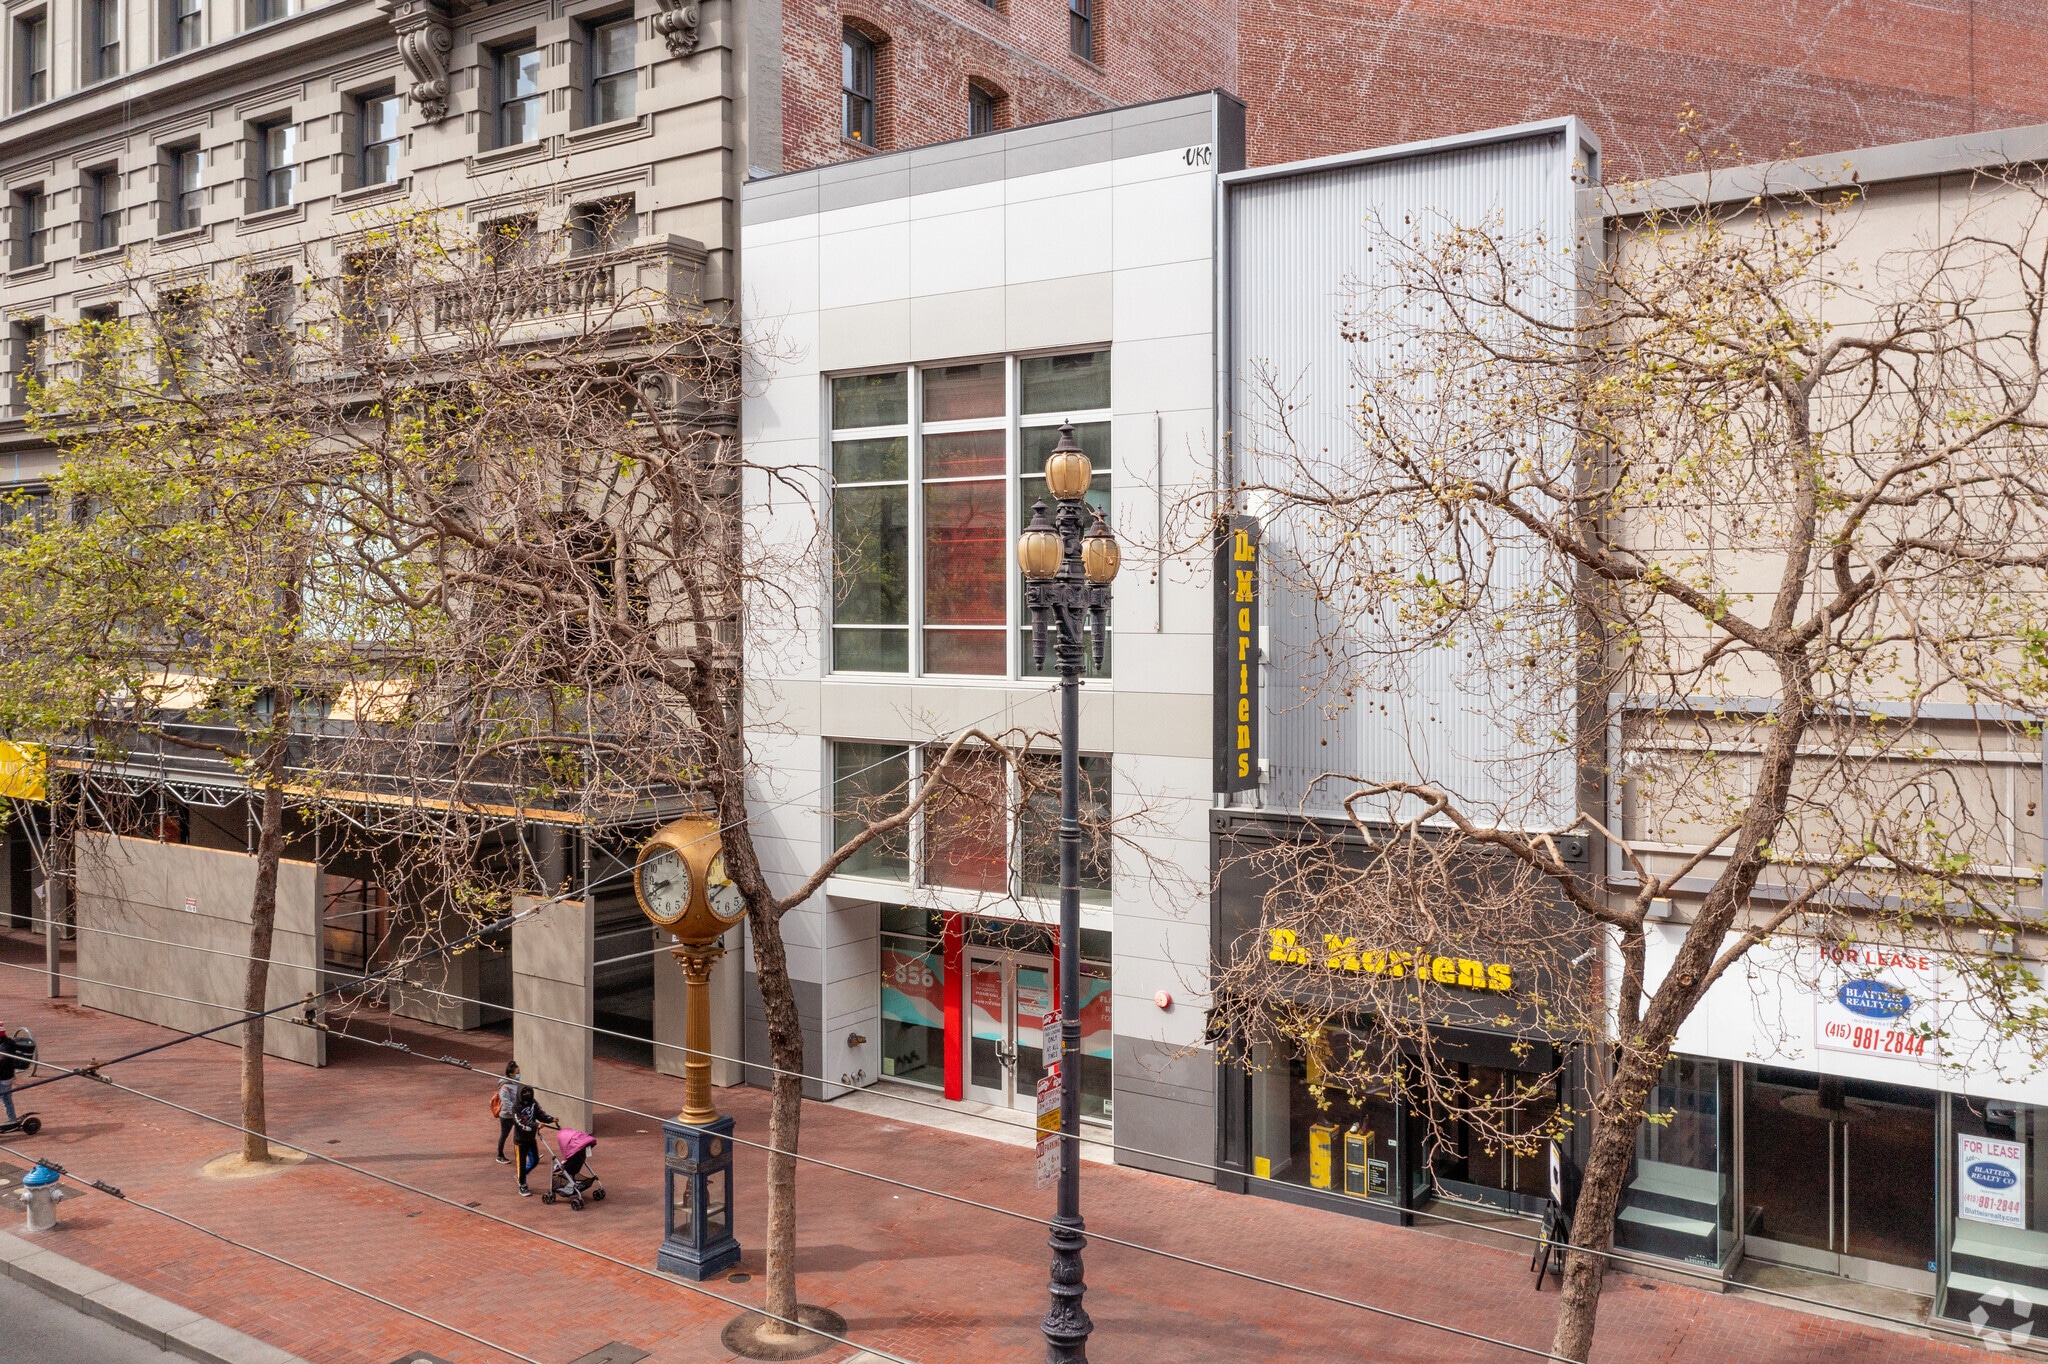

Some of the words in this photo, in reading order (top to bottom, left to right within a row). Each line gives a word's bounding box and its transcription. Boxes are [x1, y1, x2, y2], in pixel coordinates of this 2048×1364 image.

[1236, 569, 1253, 778] Martens
[665, 854, 673, 864] 12
[650, 863, 658, 874] 10
[682, 869, 687, 878] 2
[649, 875, 655, 885] 9
[683, 881, 689, 891] 3
[657, 897, 662, 907] 7
[681, 892, 687, 902] 4
[733, 896, 740, 907] 5
[665, 901, 671, 912] 6
[675, 900, 681, 910] 5
[715, 900, 721, 911] 7
[724, 901, 730, 912] 6
[1820, 947, 1859, 963] FOR
[1866, 951, 1930, 971] LEASE
[895, 964, 934, 988] 856
[1846, 998, 1886, 1009] REALTY
[1047, 1035, 1058, 1044] ONLY
[1825, 1021, 1852, 1040] (415)
[1853, 1026, 1925, 1057] 981-2844
[1047, 1050, 1058, 1060] TIMES
[1045, 1138, 1061, 1151] PARKING
[1963, 1140, 1983, 1154] FOR
[1987, 1143, 2020, 1160] LEASE
[1974, 1166, 2011, 1178] BLATTEIS
[1970, 1172, 2001, 1183] REALTY
[2002, 1177, 2015, 1185] CO
[1964, 1193, 1979, 1204] (415)
[1978, 1195, 2020, 1214] 981-2844
[1965, 1206, 2020, 1222] Blatteisrealty.com
